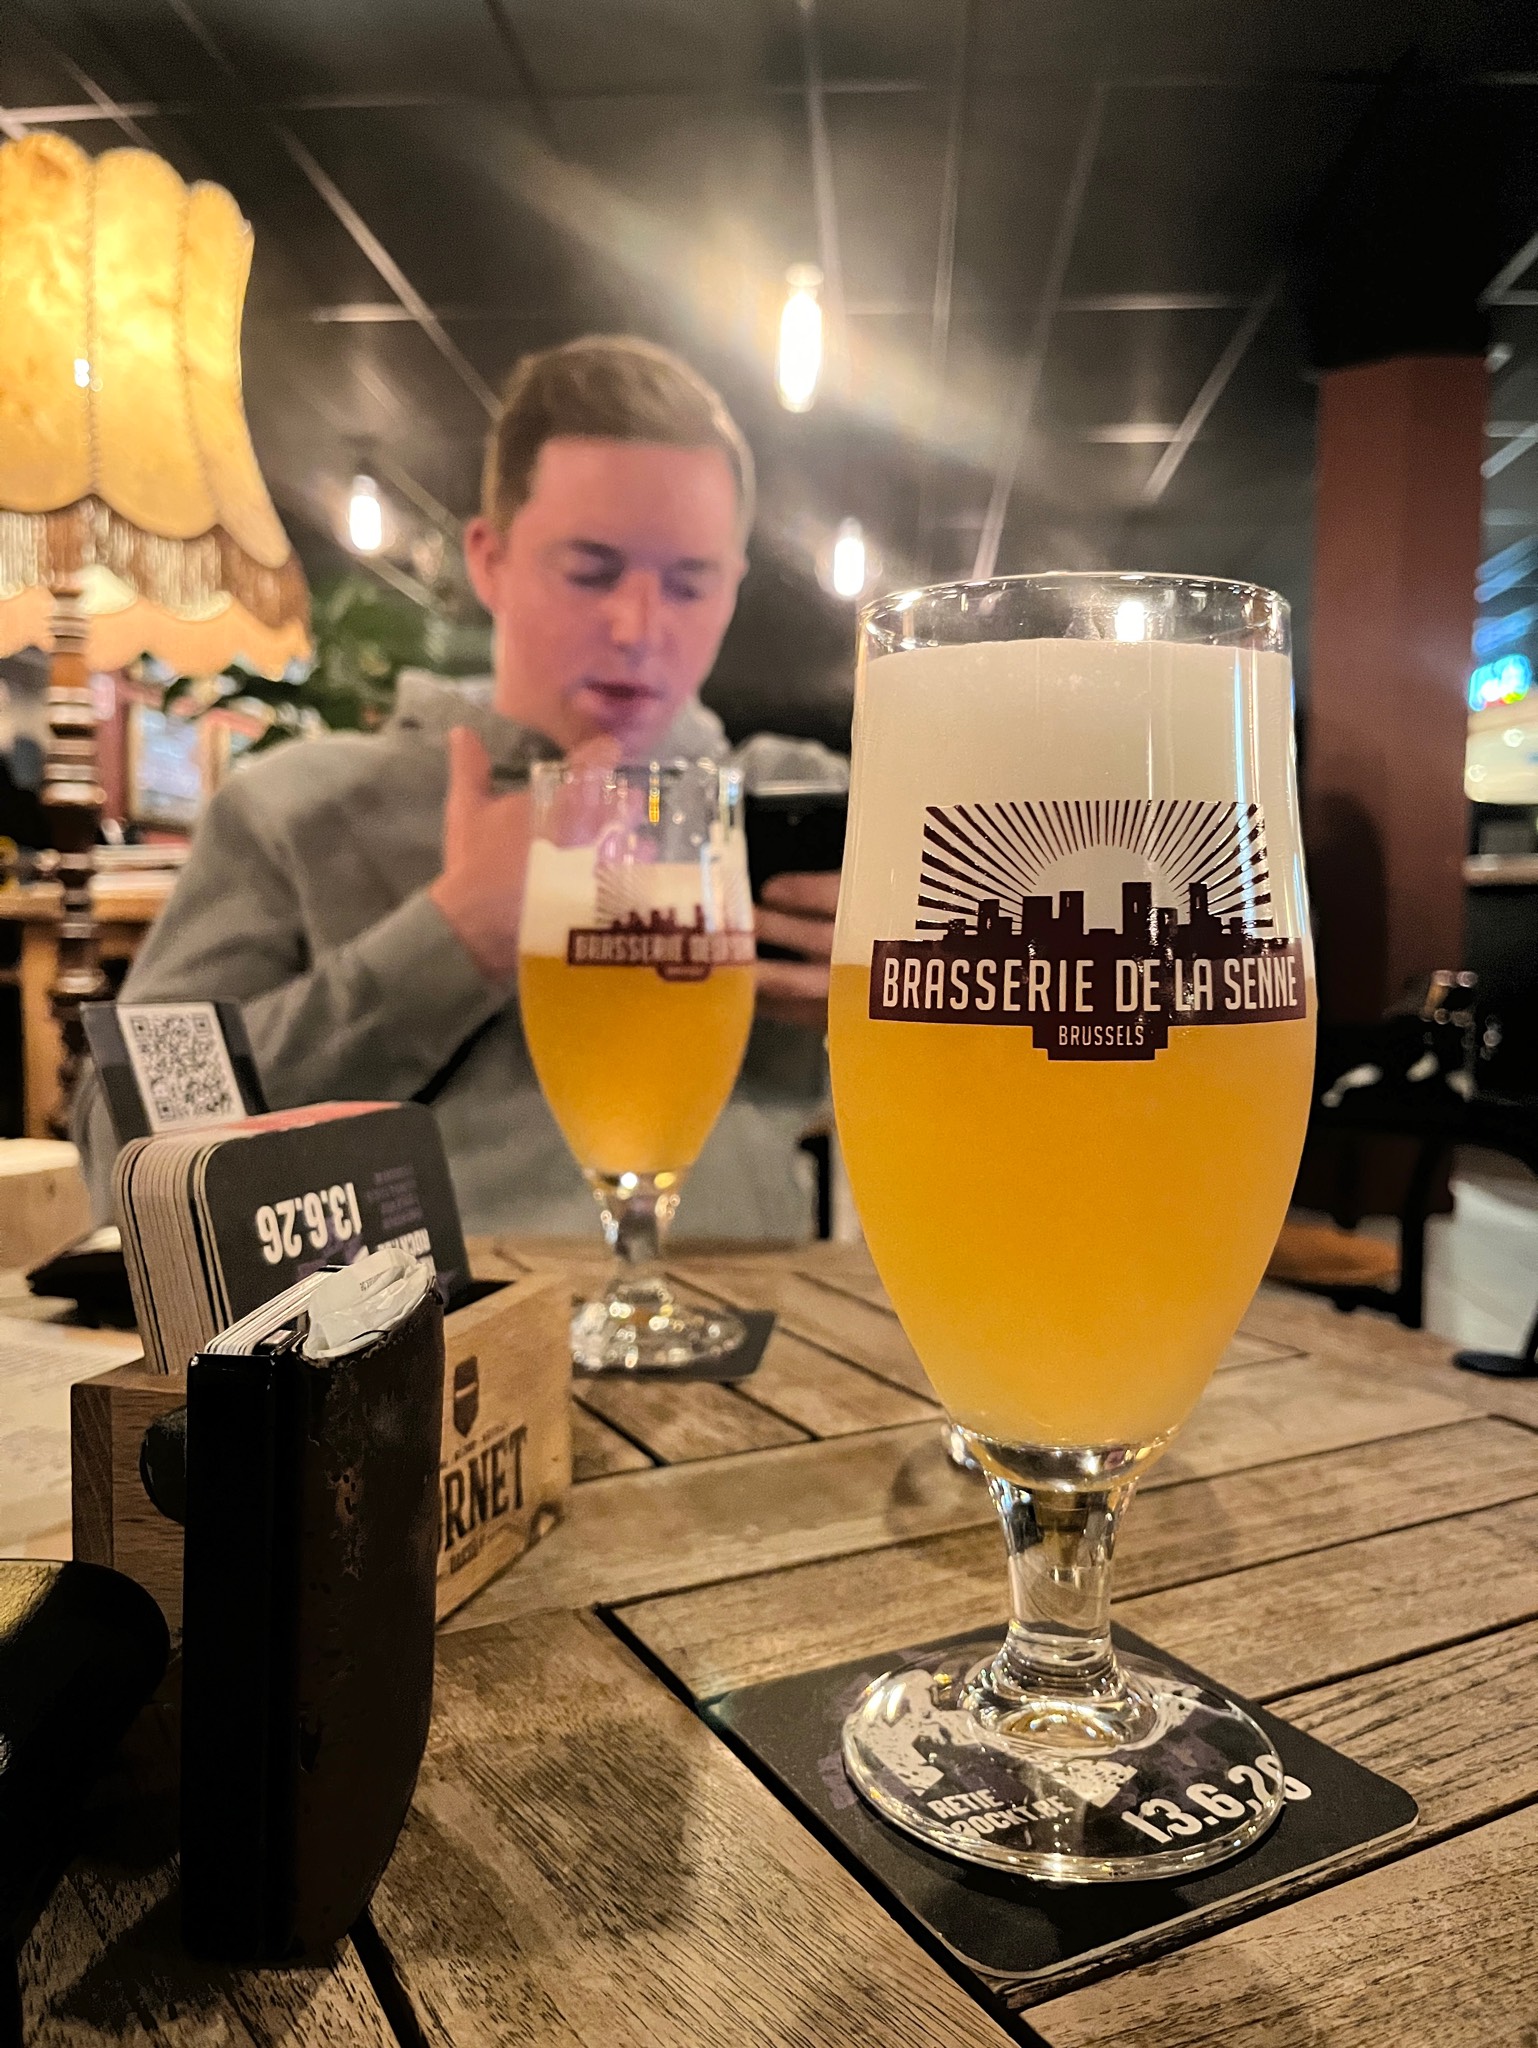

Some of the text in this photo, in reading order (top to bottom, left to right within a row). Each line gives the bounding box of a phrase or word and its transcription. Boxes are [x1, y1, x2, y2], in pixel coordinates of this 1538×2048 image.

[882, 955, 1298, 1013] BRASSERIE DE LA SENNE
[1058, 1024, 1145, 1047] BRUSSELS
[255, 1181, 363, 1265] 13.6.26
[444, 1422, 528, 1552] RNET
[926, 1788, 1005, 1820] RETIE
